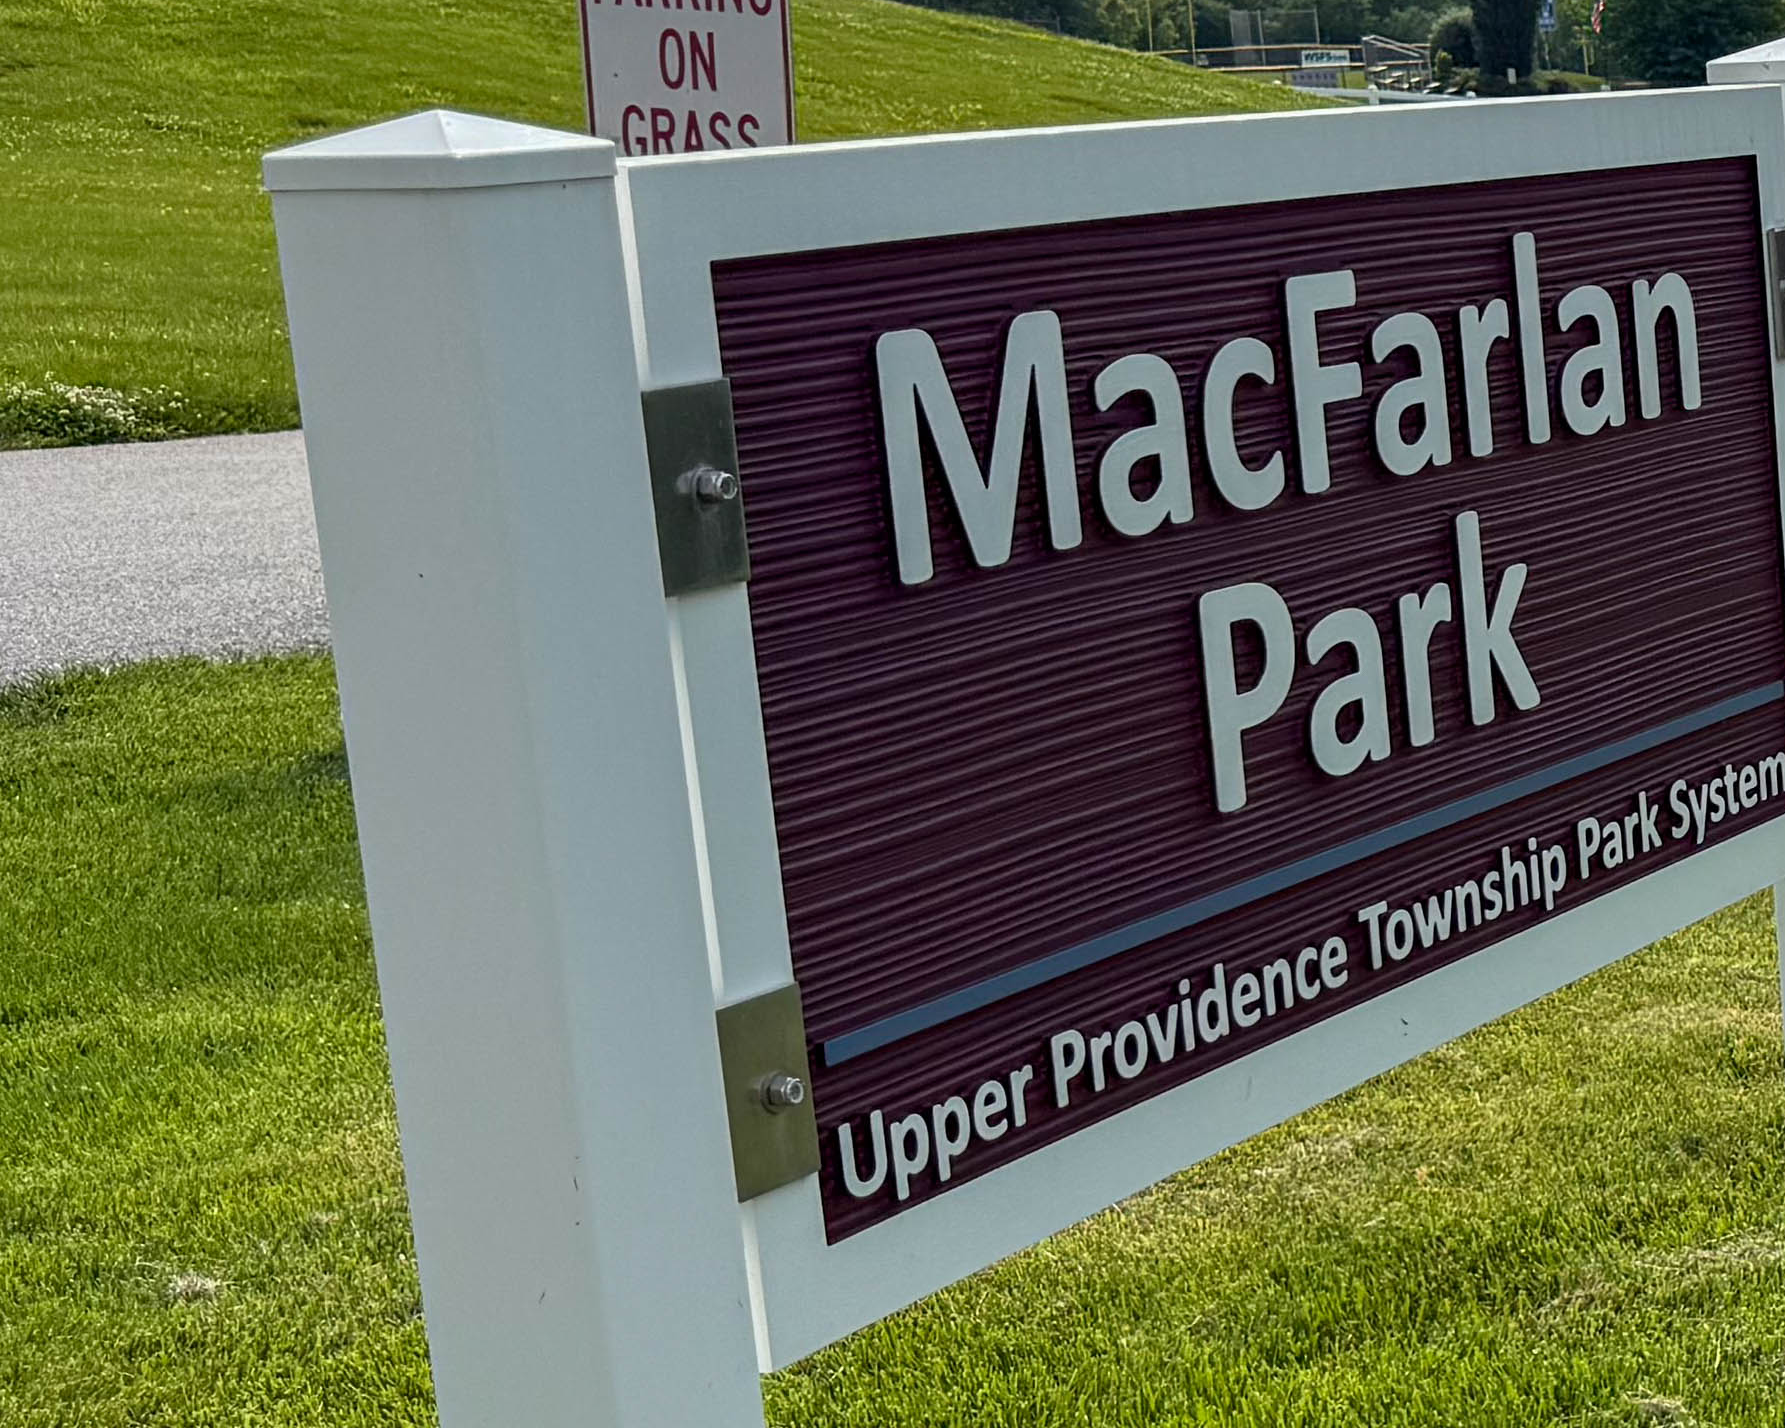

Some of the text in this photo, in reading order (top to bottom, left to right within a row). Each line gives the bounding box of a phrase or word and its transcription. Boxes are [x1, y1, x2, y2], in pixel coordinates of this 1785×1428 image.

[622, 104, 760, 157] GRASS
[659, 28, 717, 91] ON
[875, 231, 1702, 586] MacFarlan
[1199, 510, 1542, 813] Park
[837, 1064, 1033, 1201] Upper
[1050, 935, 1349, 1108] Providence
[1358, 837, 1567, 971] Township
[1577, 791, 1662, 880] Park
